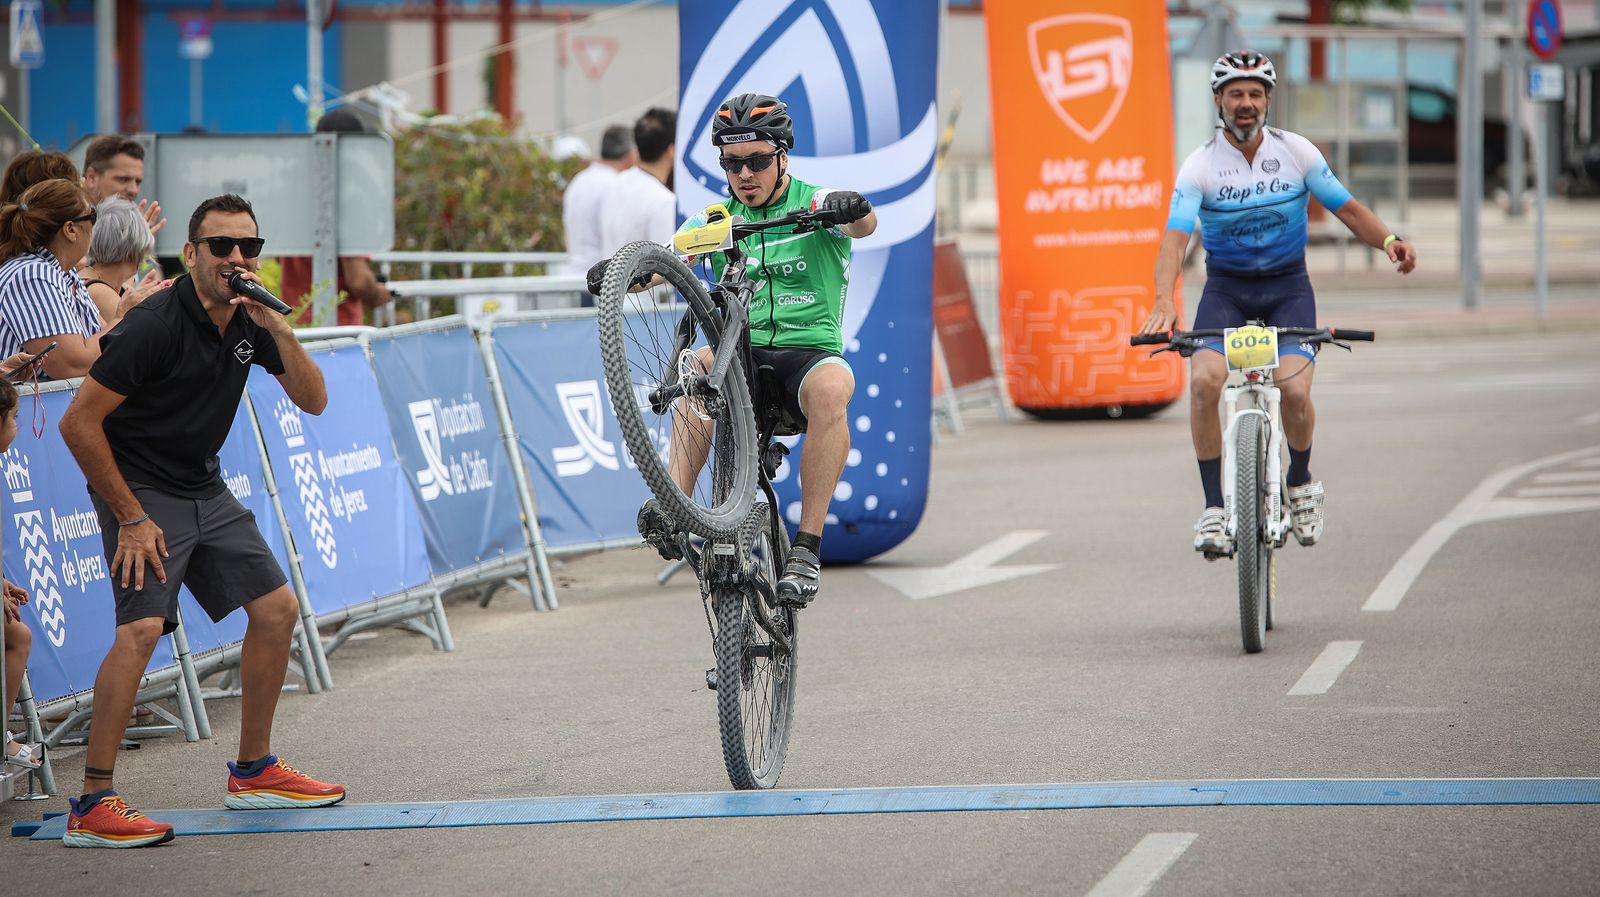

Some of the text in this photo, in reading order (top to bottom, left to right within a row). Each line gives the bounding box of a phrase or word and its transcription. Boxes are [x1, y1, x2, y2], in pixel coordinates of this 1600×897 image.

[726, 134, 751, 142] MORVÉLO
[1041, 155, 1145, 185] WE ARE
[1025, 180, 1163, 214] NUTRITION!
[1216, 177, 1291, 204] Stop & Go
[778, 294, 816, 306] CARUSO
[1231, 334, 1272, 349] 604
[432, 392, 486, 443] Diputación
[317, 441, 382, 488] Ayuntamiento
[449, 454, 467, 495] de
[329, 485, 369, 523] de Jerez
[50, 507, 102, 551] Ayuntam
[61, 549, 106, 593] de Jerez
